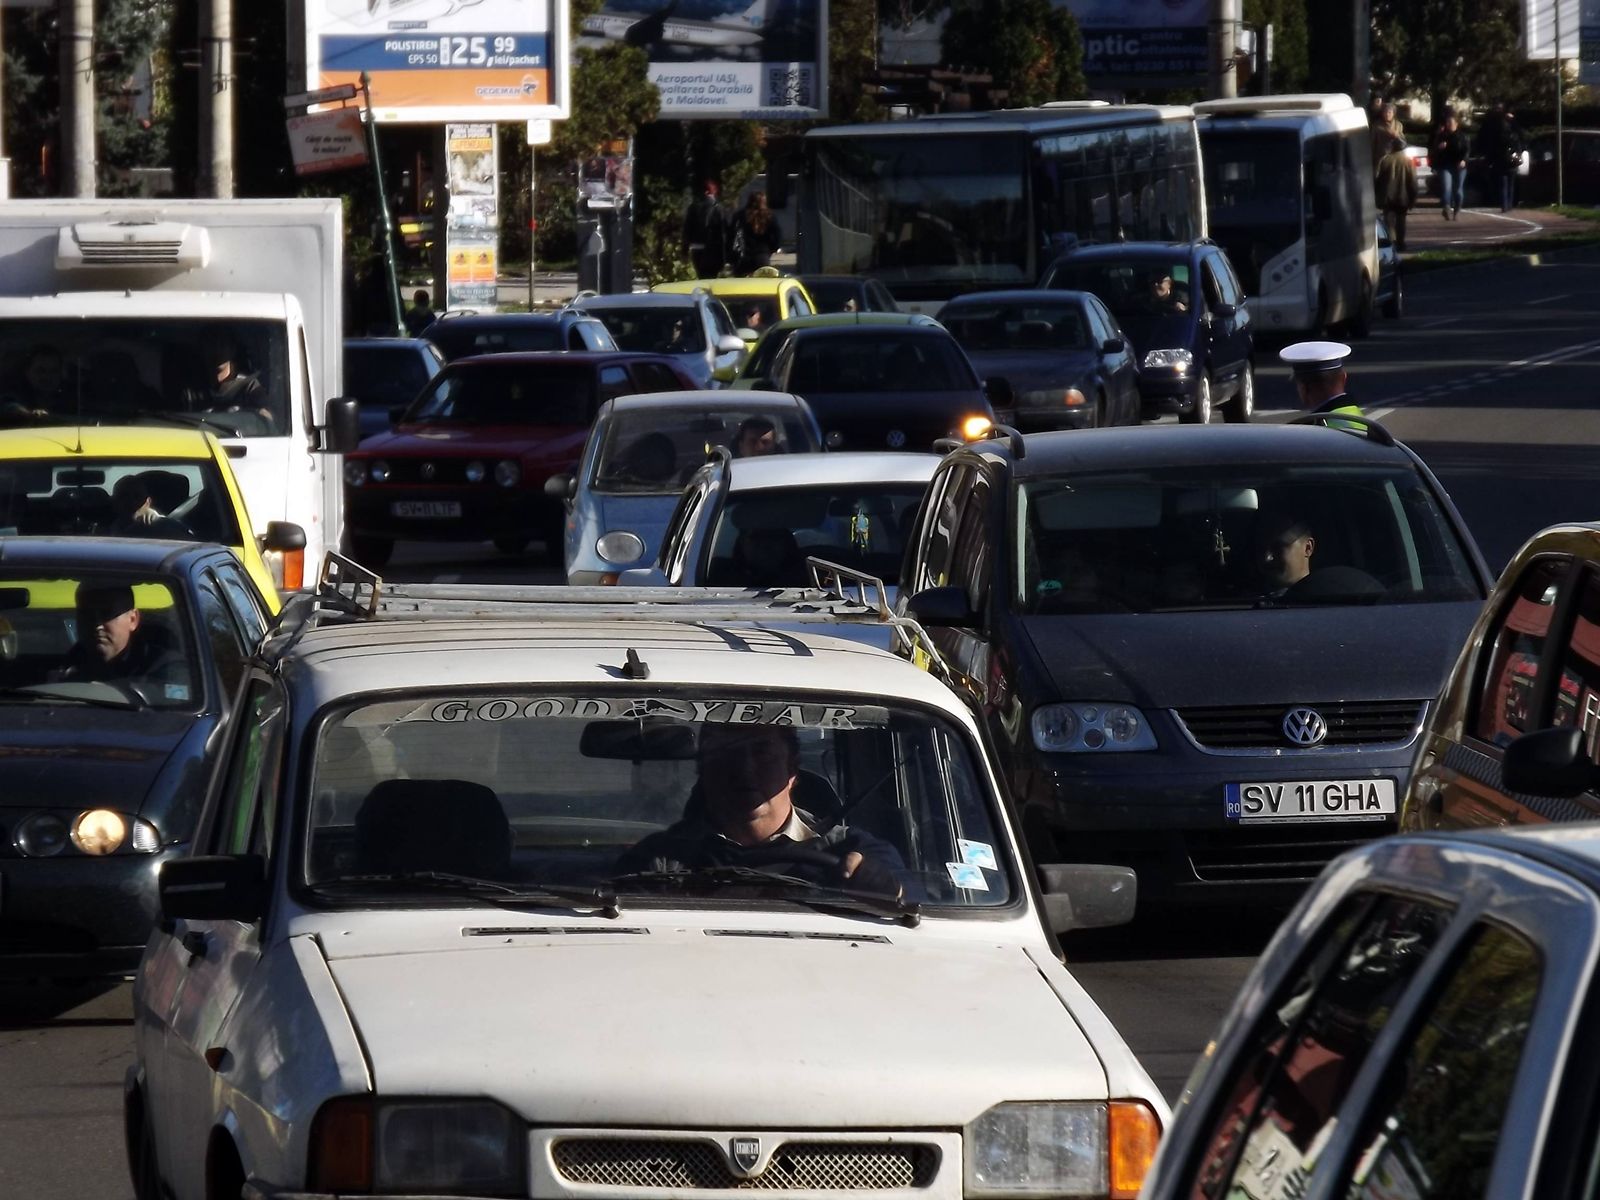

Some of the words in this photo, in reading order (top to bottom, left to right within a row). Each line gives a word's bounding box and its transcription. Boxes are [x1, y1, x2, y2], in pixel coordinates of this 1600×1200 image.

[385, 40, 438, 51] POLISTIREN
[1080, 33, 1140, 59] ptic
[408, 54, 424, 65] EPS
[426, 54, 437, 64] 50
[495, 54, 540, 67] lei/pachet
[656, 74, 713, 85] Aeroportul
[660, 85, 705, 95] voltarea
[430, 698, 611, 723] GOOD
[687, 700, 858, 729] YEAR
[1228, 802, 1240, 814] RO
[1242, 785, 1284, 814] SV
[1295, 785, 1315, 812] 11
[1322, 783, 1381, 811] GHA
